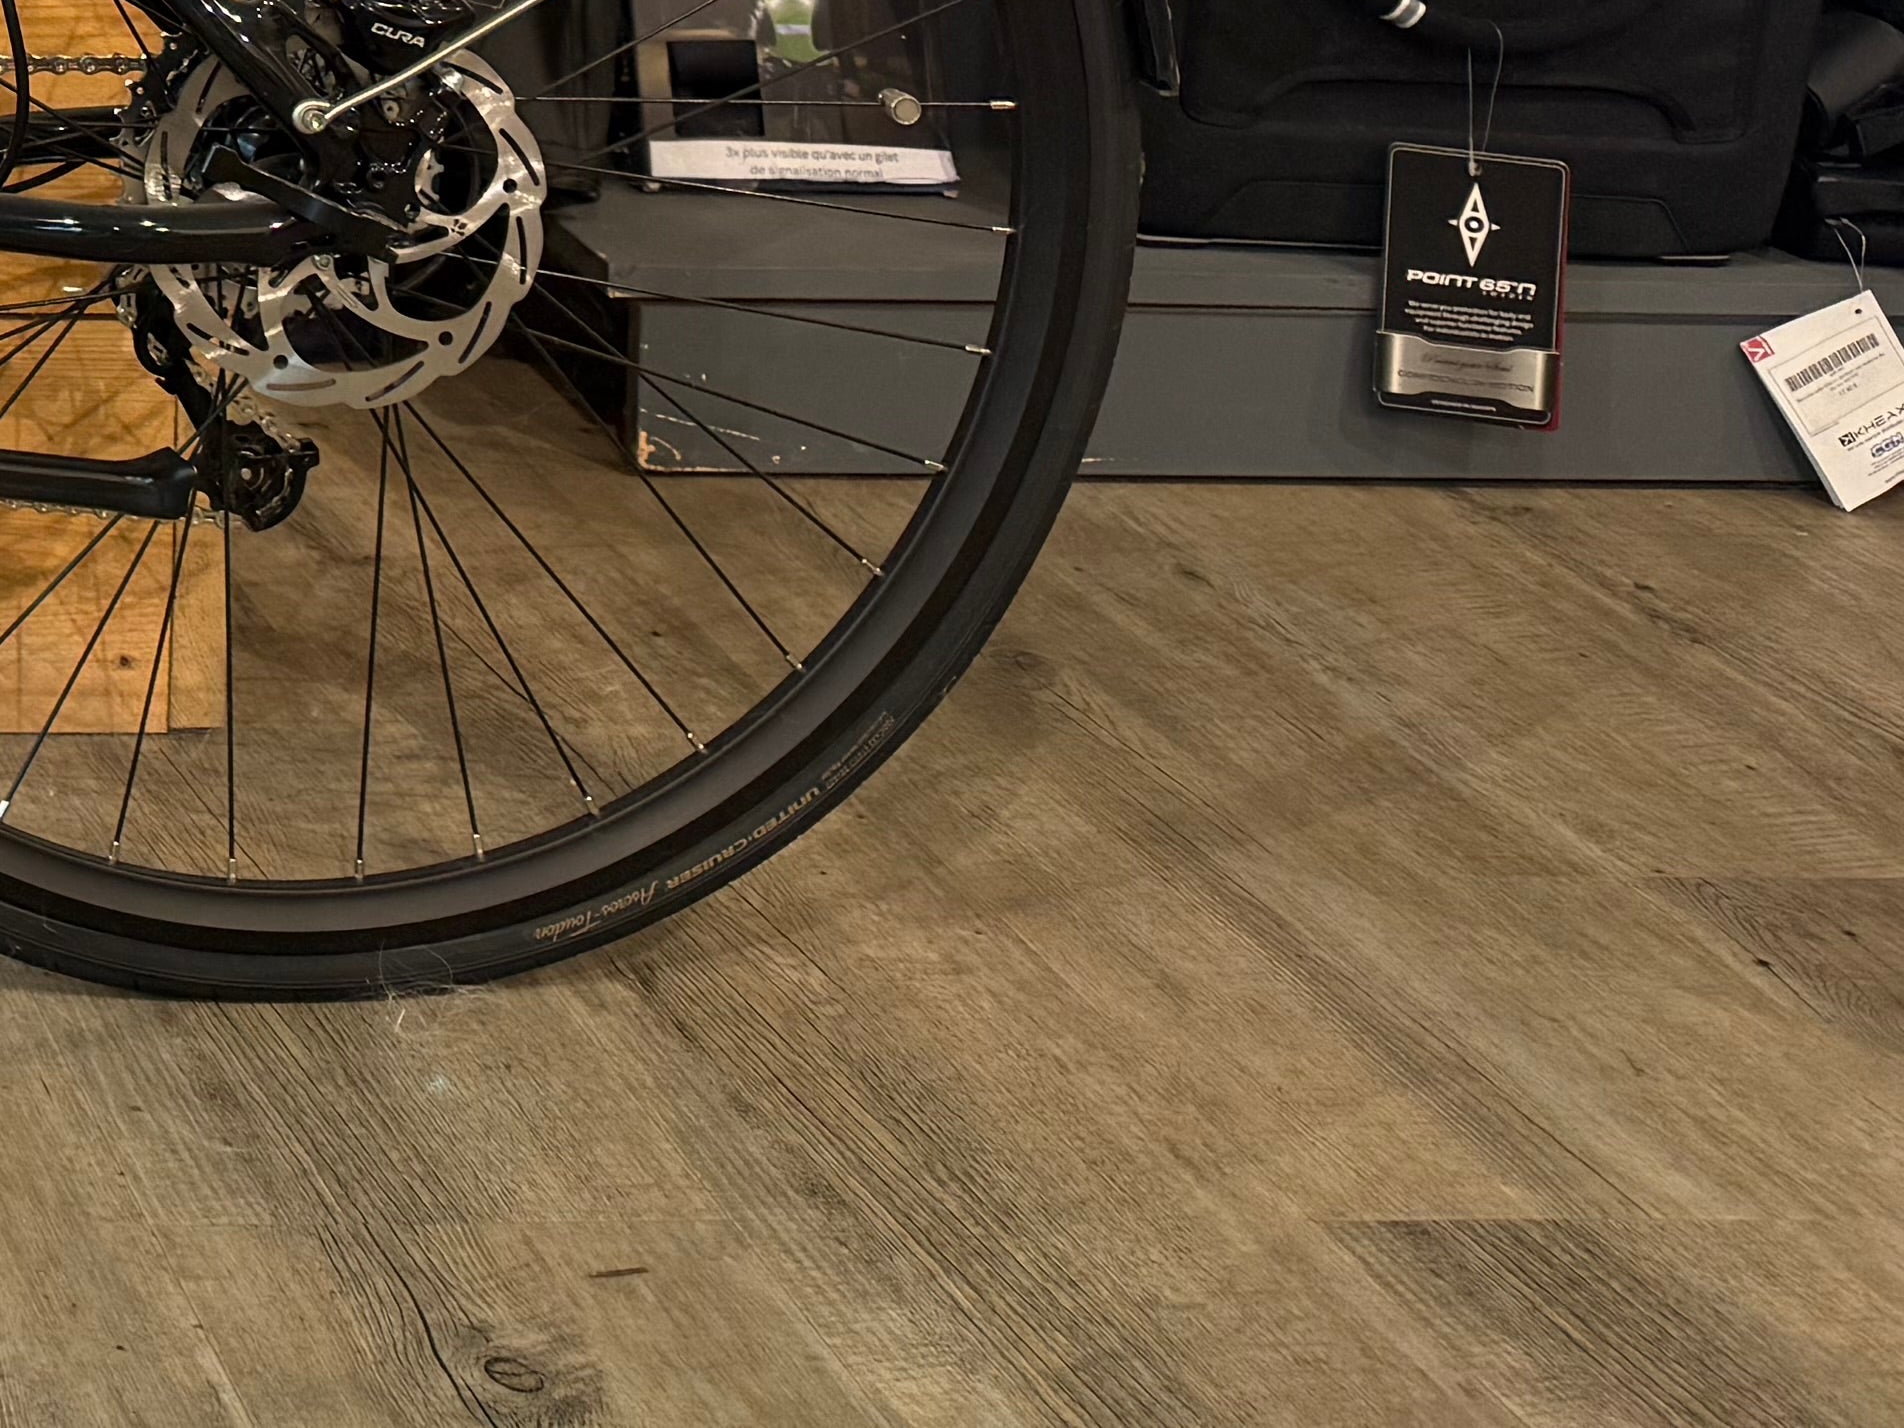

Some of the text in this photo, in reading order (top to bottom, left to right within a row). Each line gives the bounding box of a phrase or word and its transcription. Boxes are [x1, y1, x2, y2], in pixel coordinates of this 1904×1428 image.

[743, 148, 768, 162] plus
[771, 149, 808, 159] visible
[858, 153, 872, 161] un
[875, 152, 898, 164] gilet
[750, 166, 884, 178] de signalisation normal
[1407, 270, 1478, 288] POINT
